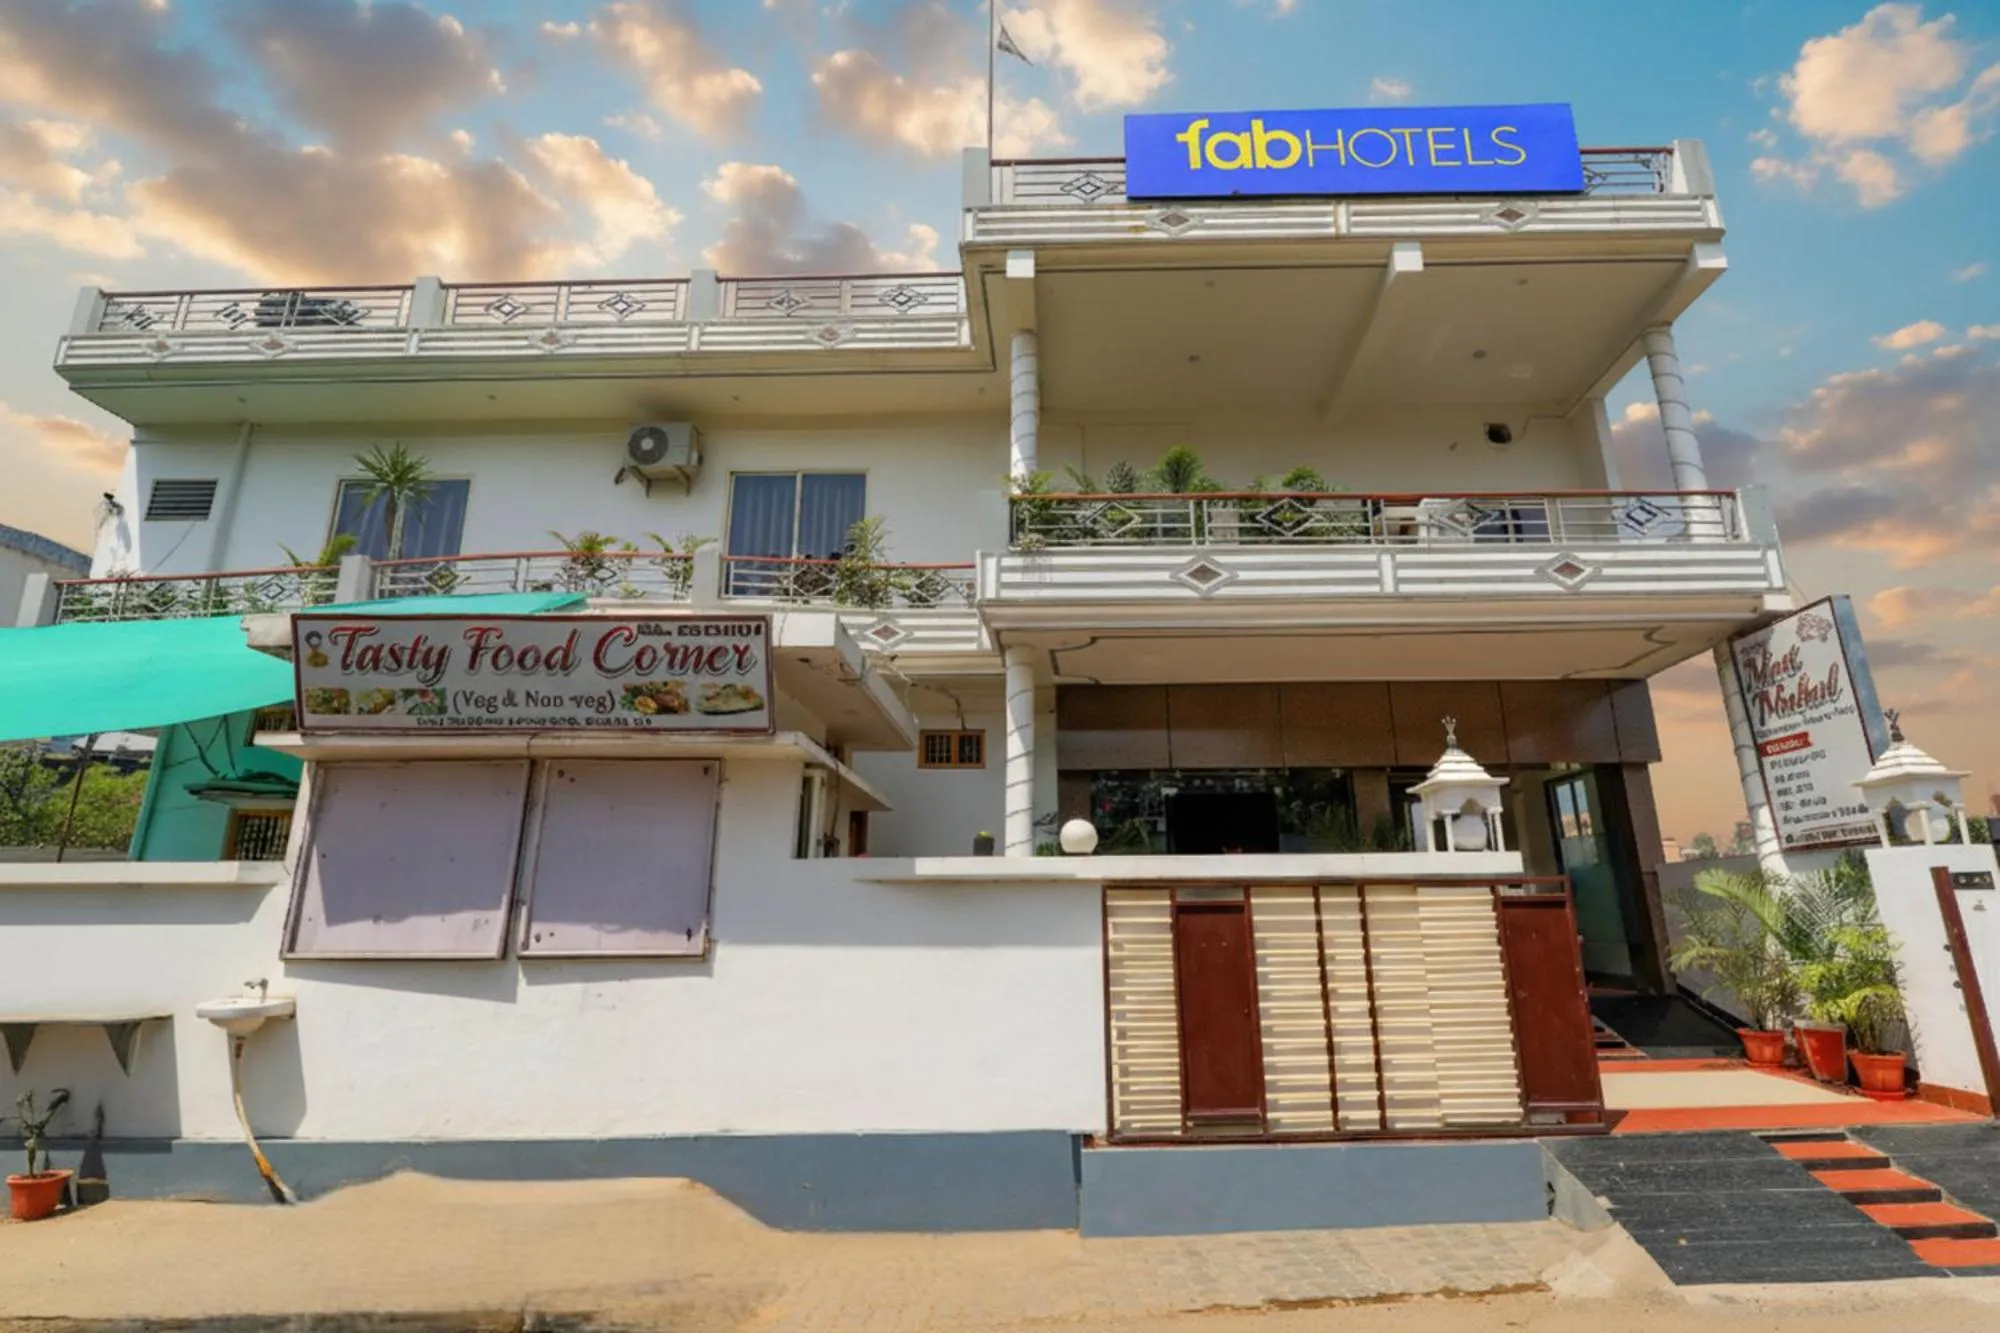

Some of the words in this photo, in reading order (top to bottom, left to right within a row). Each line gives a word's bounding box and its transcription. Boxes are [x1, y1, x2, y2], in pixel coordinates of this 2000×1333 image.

[1176, 119, 1527, 170] fabHOTELS
[328, 625, 452, 686] Tasty
[463, 625, 581, 676] Food
[593, 622, 759, 678] Corner
[453, 690, 498, 714] (Veg
[502, 689, 518, 708] &
